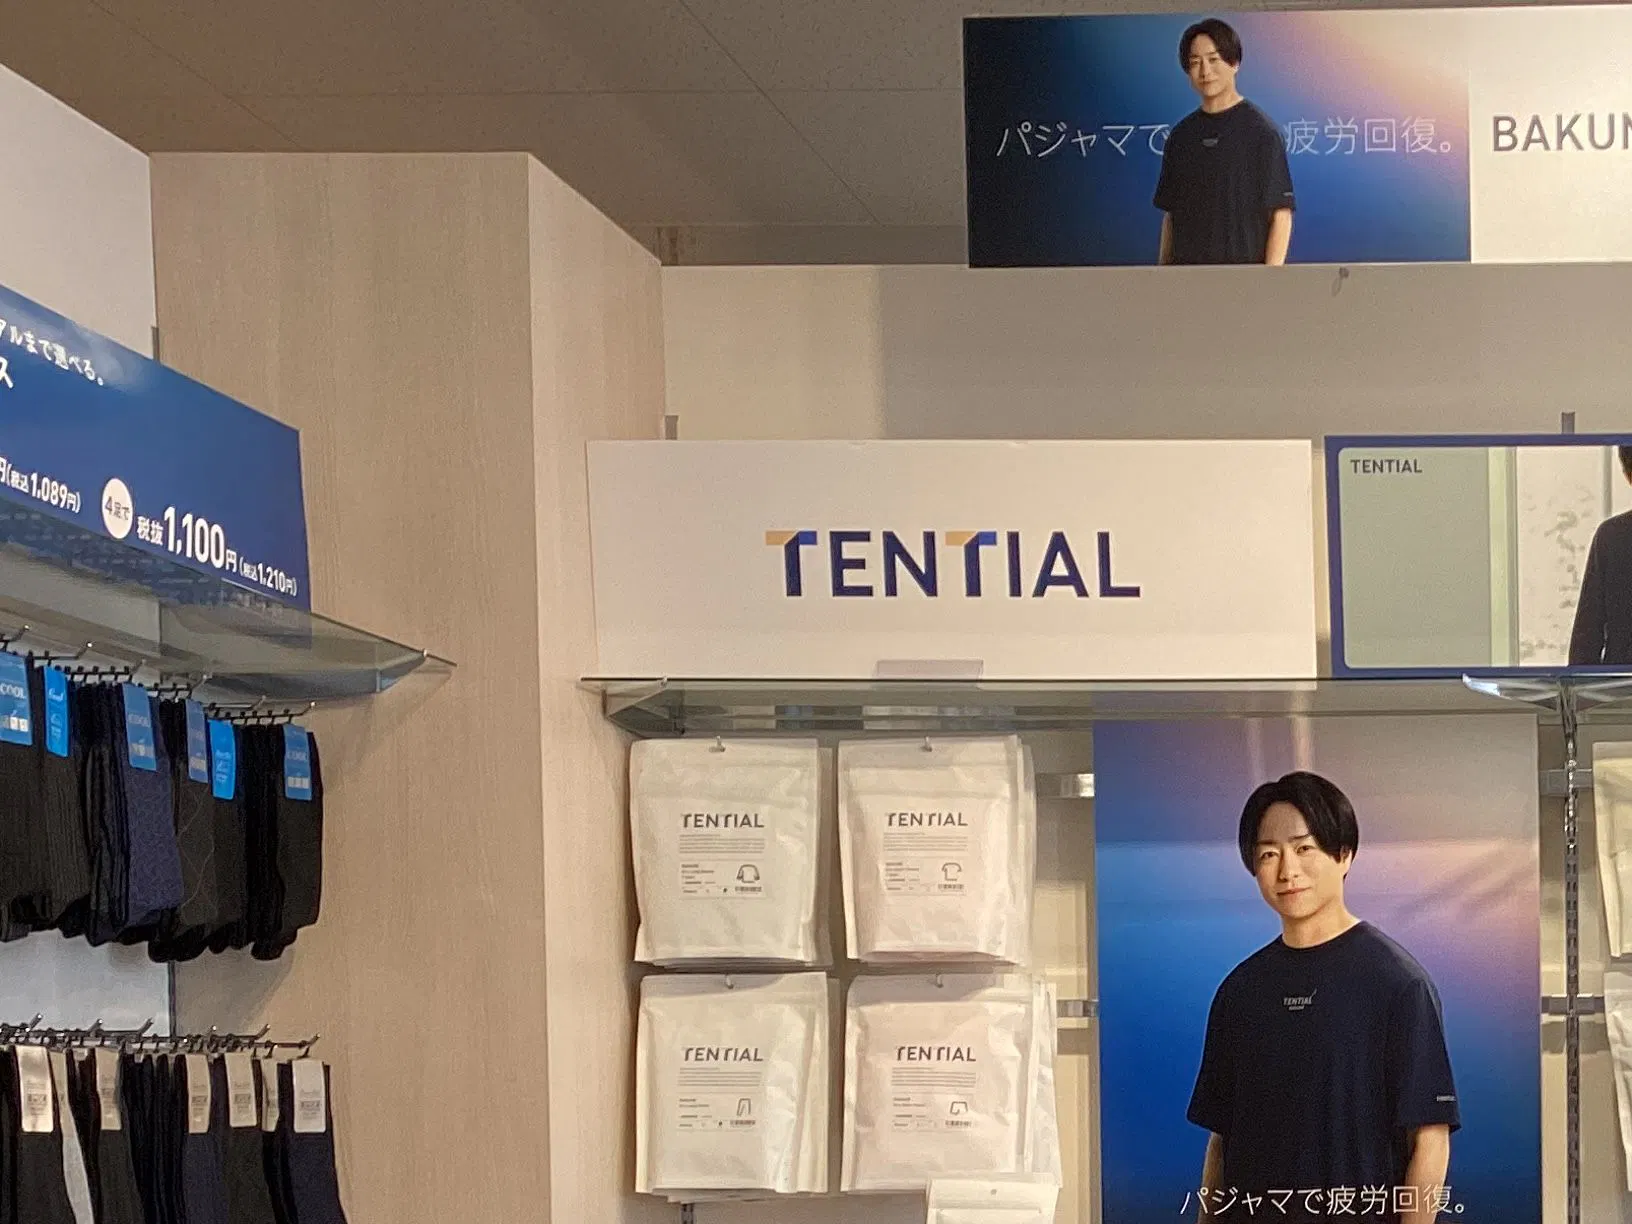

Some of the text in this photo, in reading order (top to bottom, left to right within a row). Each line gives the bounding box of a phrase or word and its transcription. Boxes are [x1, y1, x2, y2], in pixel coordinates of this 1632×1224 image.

[996, 116, 1453, 158] パジャマで 疲労回復。
[1349, 459, 1423, 475] TENTIAL
[765, 530, 1142, 598] TENTIAL
[682, 812, 765, 829] TENTIAL
[886, 811, 969, 827] TENTIAL
[683, 1046, 764, 1062] TENTIAL
[896, 1046, 977, 1062] TENTIAL
[1179, 1184, 1466, 1215] パジャマで疲労回復。
